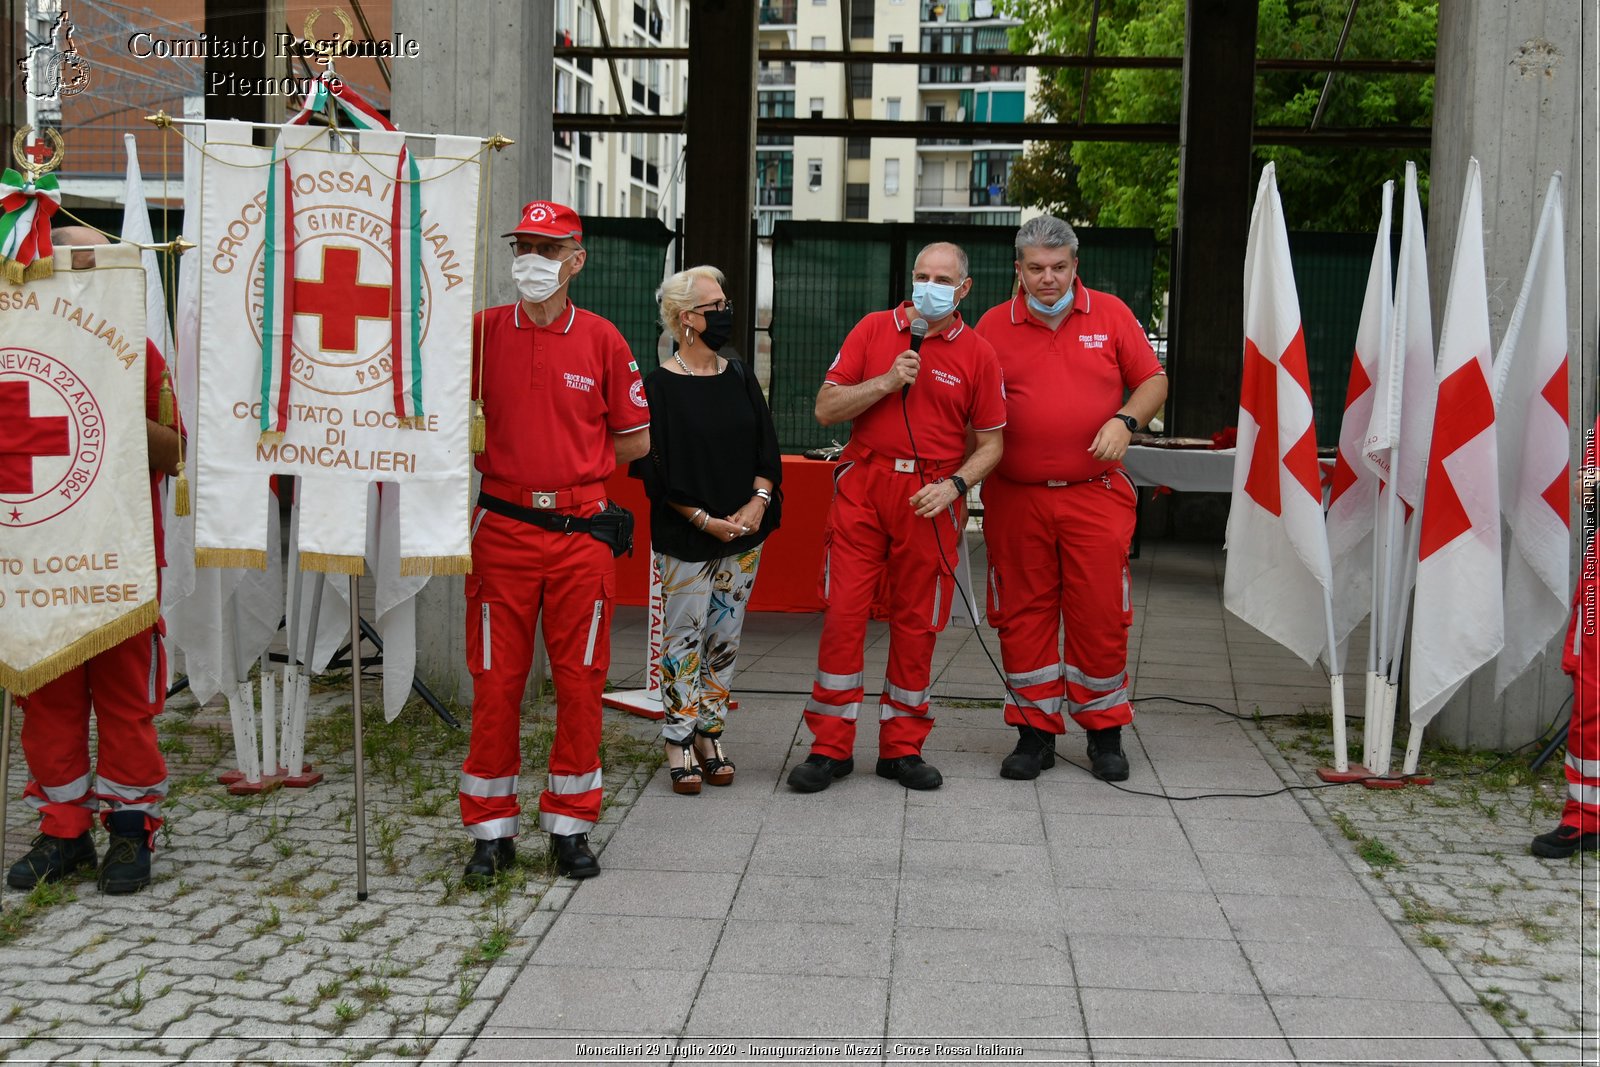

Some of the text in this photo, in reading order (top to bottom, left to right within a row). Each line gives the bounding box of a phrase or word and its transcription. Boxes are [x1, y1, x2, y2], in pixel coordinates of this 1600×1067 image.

[212, 190, 266, 274] CROCE
[53, 297, 139, 370] ITALIANA
[53, 370, 75, 392] 22
[563, 372, 580, 383] CROCE
[566, 380, 591, 393] ITALIANA
[70, 391, 100, 464] AGOSTO
[232, 401, 439, 432] COITATO LOCALE
[325, 427, 346, 447] DI
[256, 442, 416, 473] MONCALIERI
[59, 467, 91, 500] 1864
[33, 552, 119, 575] LOCALE
[15, 584, 139, 608] TORINESE
[649, 595, 662, 692] ITALIANA
